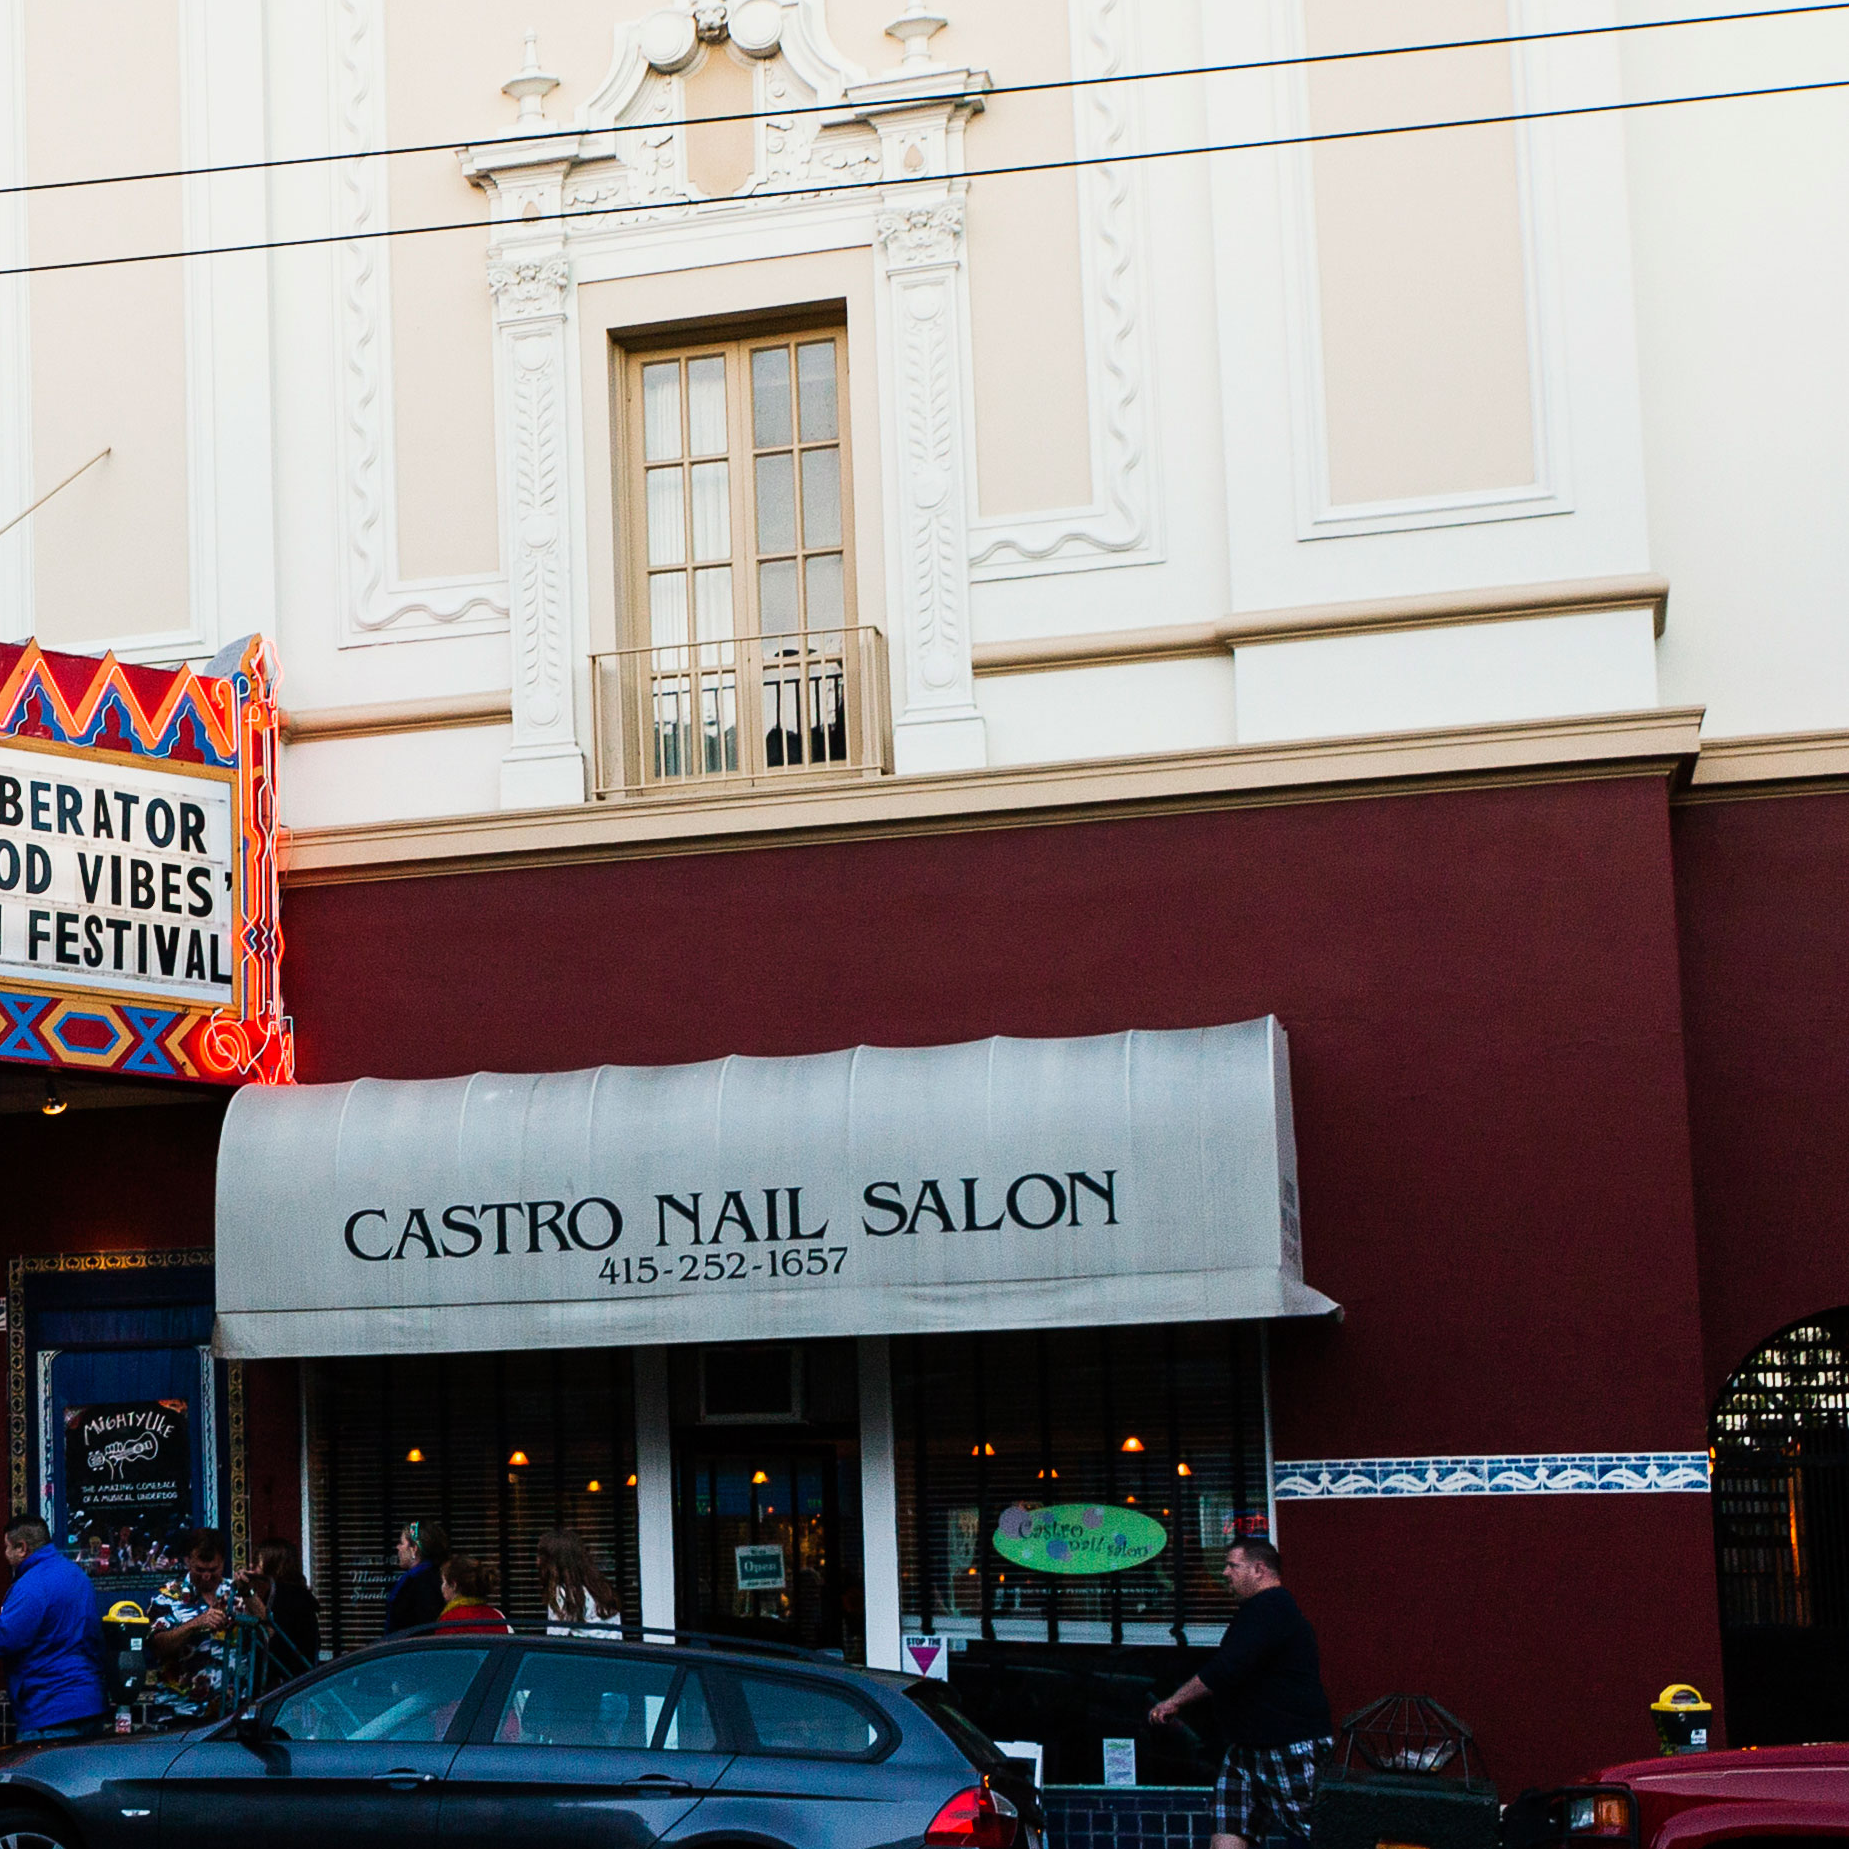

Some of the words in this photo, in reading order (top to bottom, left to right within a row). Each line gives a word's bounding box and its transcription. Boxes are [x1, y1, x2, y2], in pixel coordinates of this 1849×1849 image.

[28, 910, 232, 985] FESTIVAL
[343, 1196, 623, 1263] CASTRO
[654, 1186, 830, 1248] NAIL
[859, 1169, 1121, 1238] SALON
[598, 1246, 849, 1286] 415-252-1657
[744, 1560, 777, 1574] Open
[906, 1637, 926, 1646] STOP
